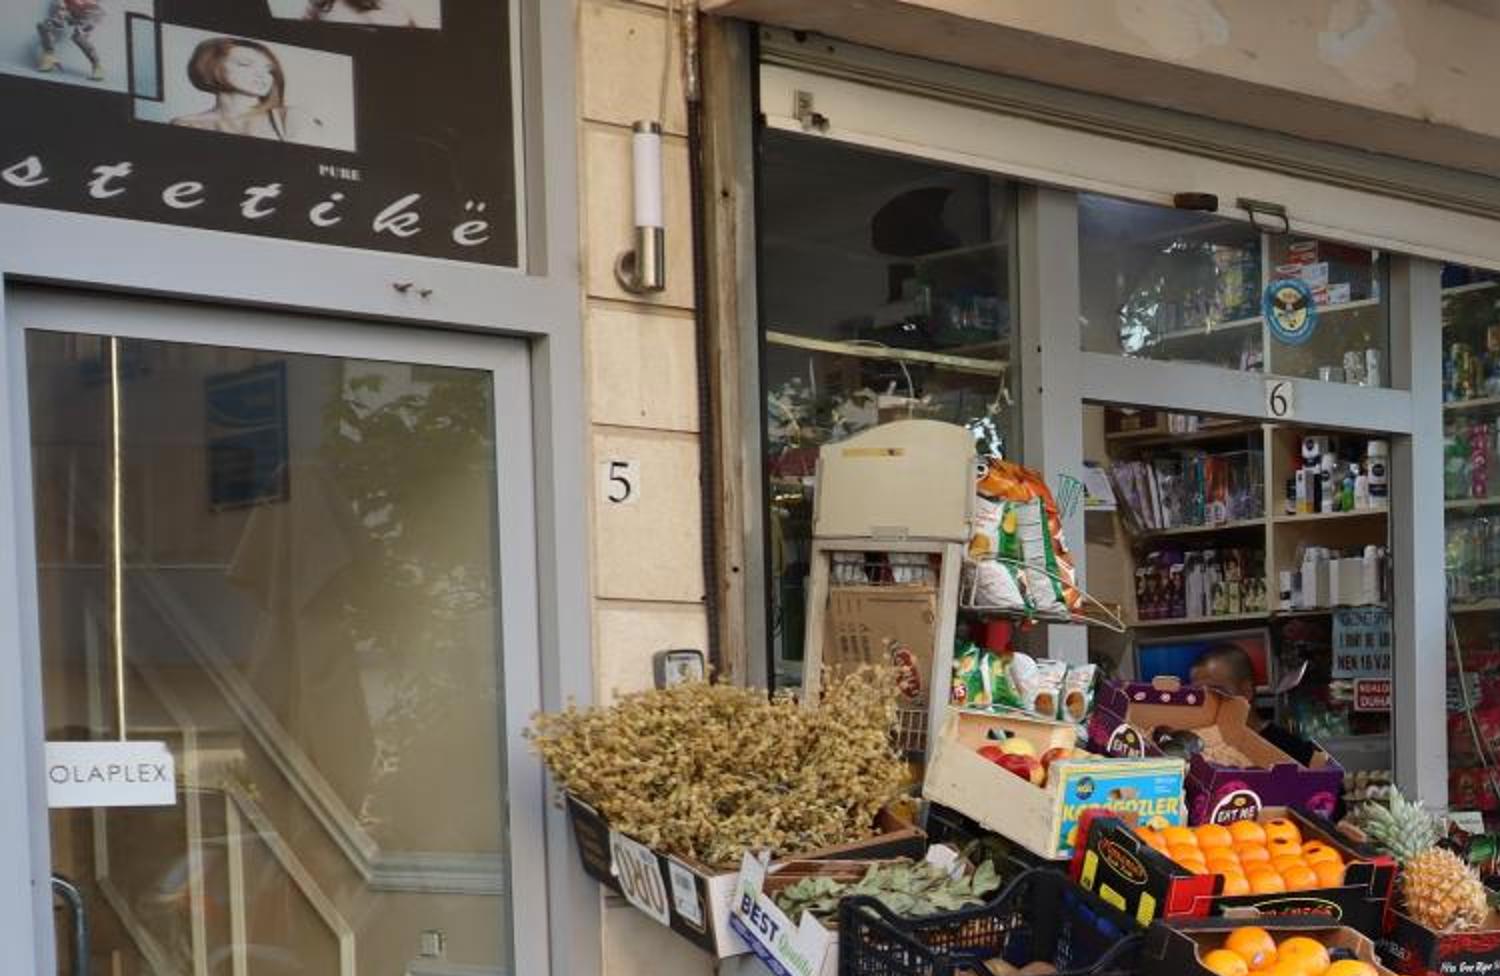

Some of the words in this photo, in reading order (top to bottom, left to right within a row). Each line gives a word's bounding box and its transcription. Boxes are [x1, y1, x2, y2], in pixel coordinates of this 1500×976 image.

[318, 163, 361, 182] PURE
[1269, 382, 1290, 417] 6
[607, 461, 633, 502] 5
[49, 763, 167, 785] OLAPLEX
[740, 893, 779, 944] BEST
